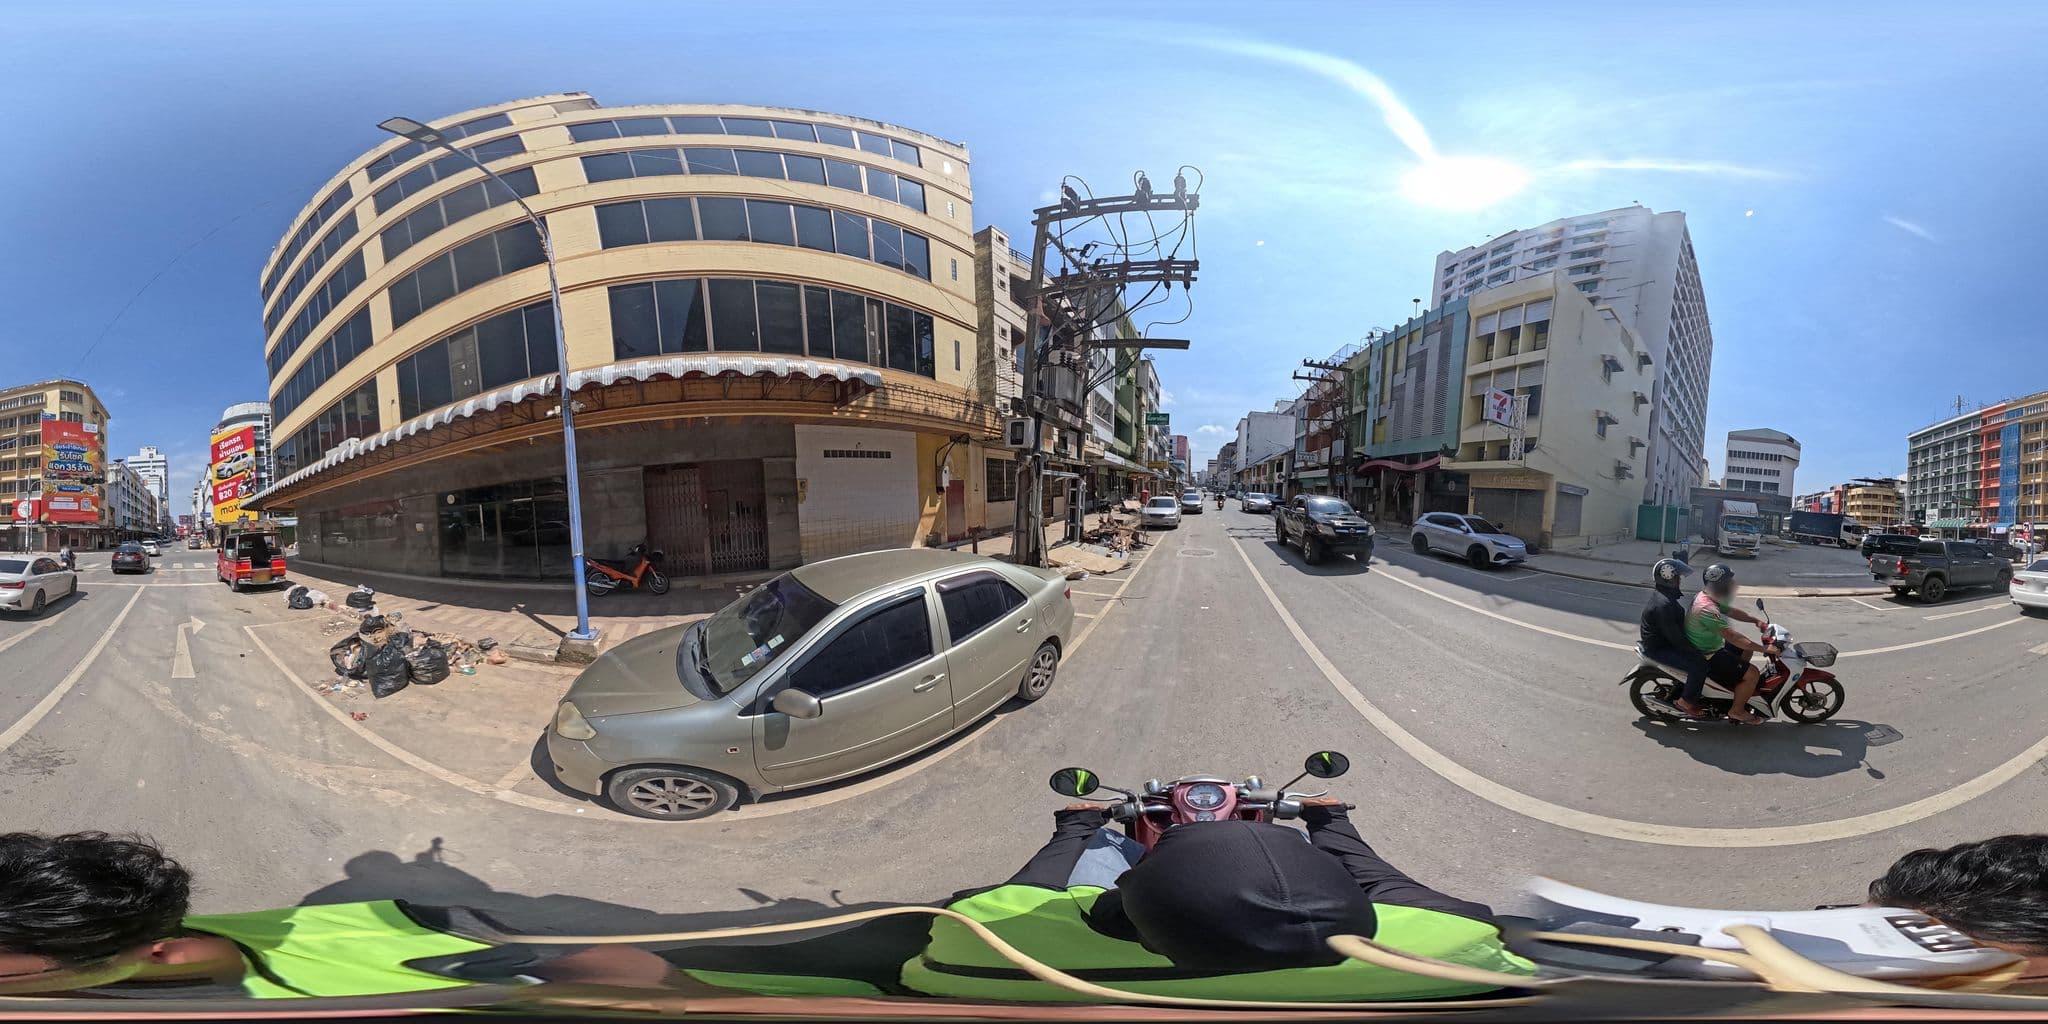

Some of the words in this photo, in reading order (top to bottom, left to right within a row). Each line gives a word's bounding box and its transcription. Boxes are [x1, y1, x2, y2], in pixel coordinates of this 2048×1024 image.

[219, 436, 241, 449] เรียกรถ
[60, 452, 83, 460] รับโชค
[66, 463, 77, 471] 35
